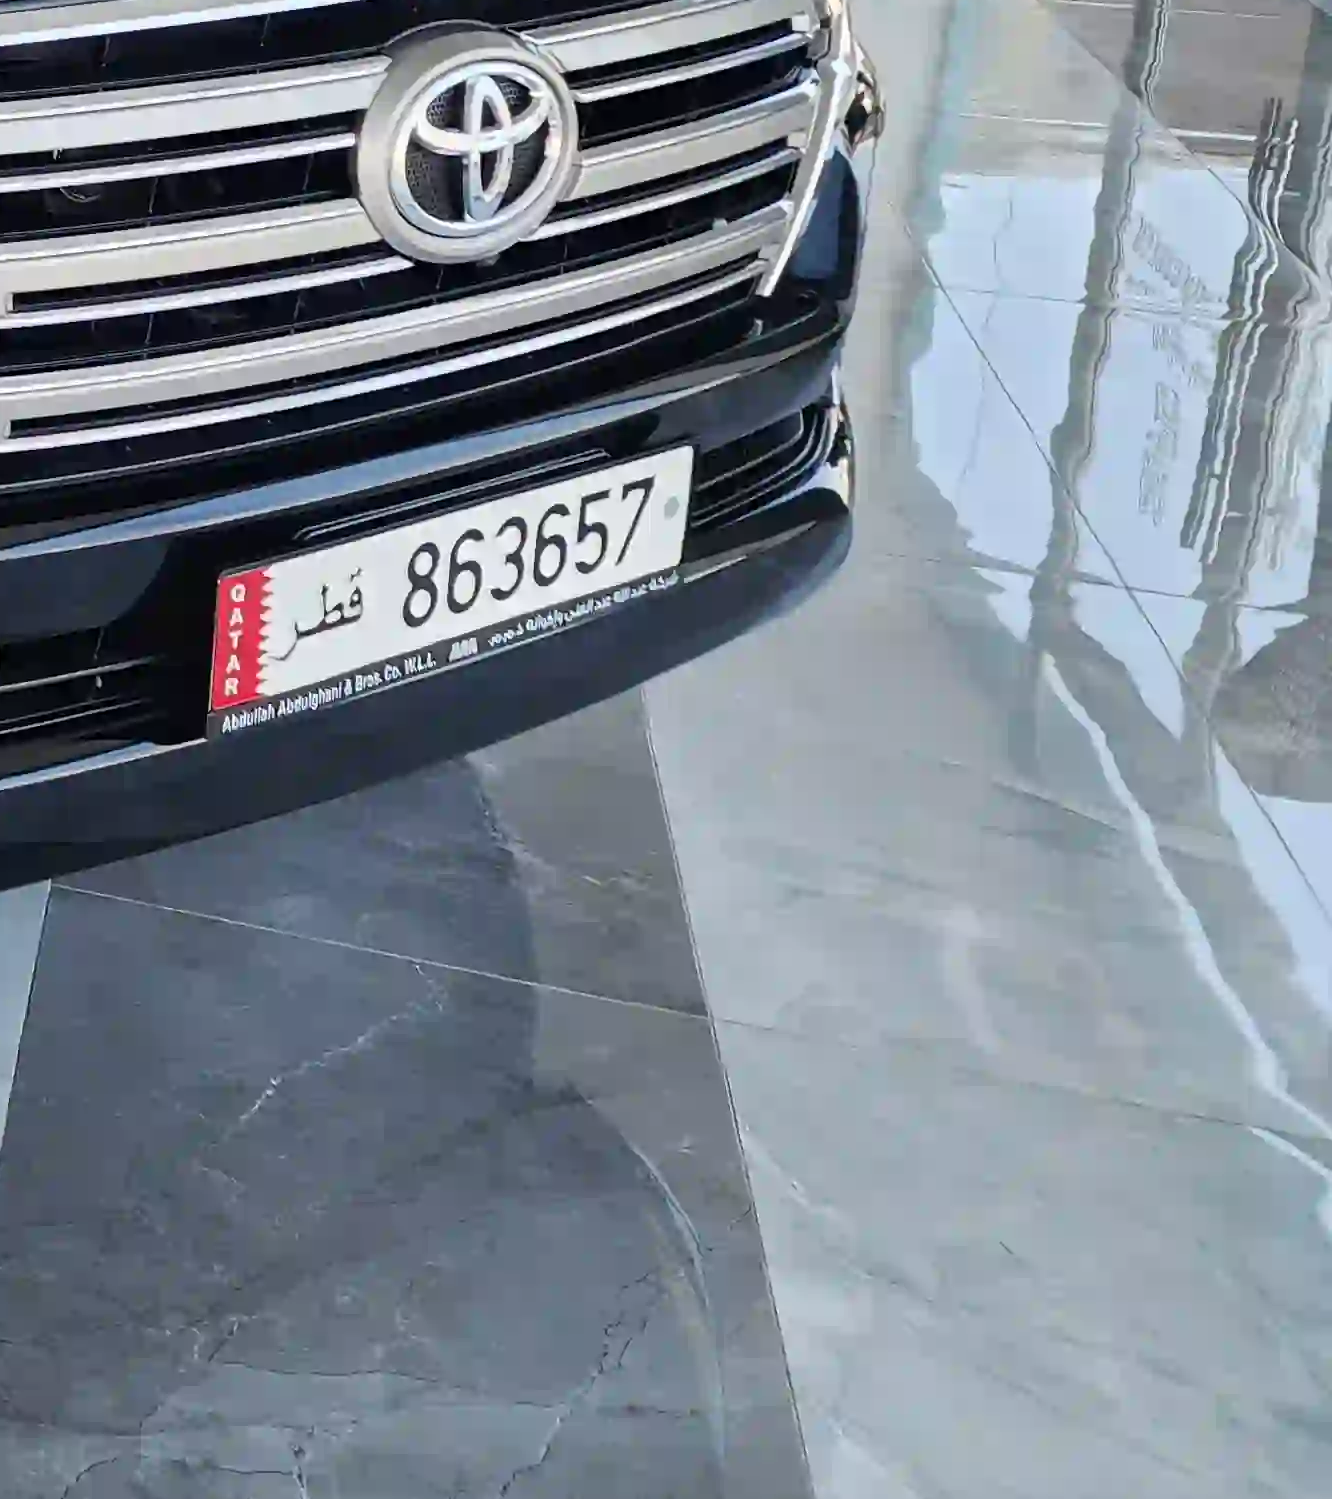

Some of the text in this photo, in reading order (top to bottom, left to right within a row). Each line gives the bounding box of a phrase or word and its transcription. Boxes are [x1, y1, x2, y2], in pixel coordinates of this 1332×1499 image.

[402, 477, 657, 629] 863657
[266, 566, 365, 662] قطر
[222, 703, 276, 734] Abdullah
[276, 682, 343, 718] Abdulghani
